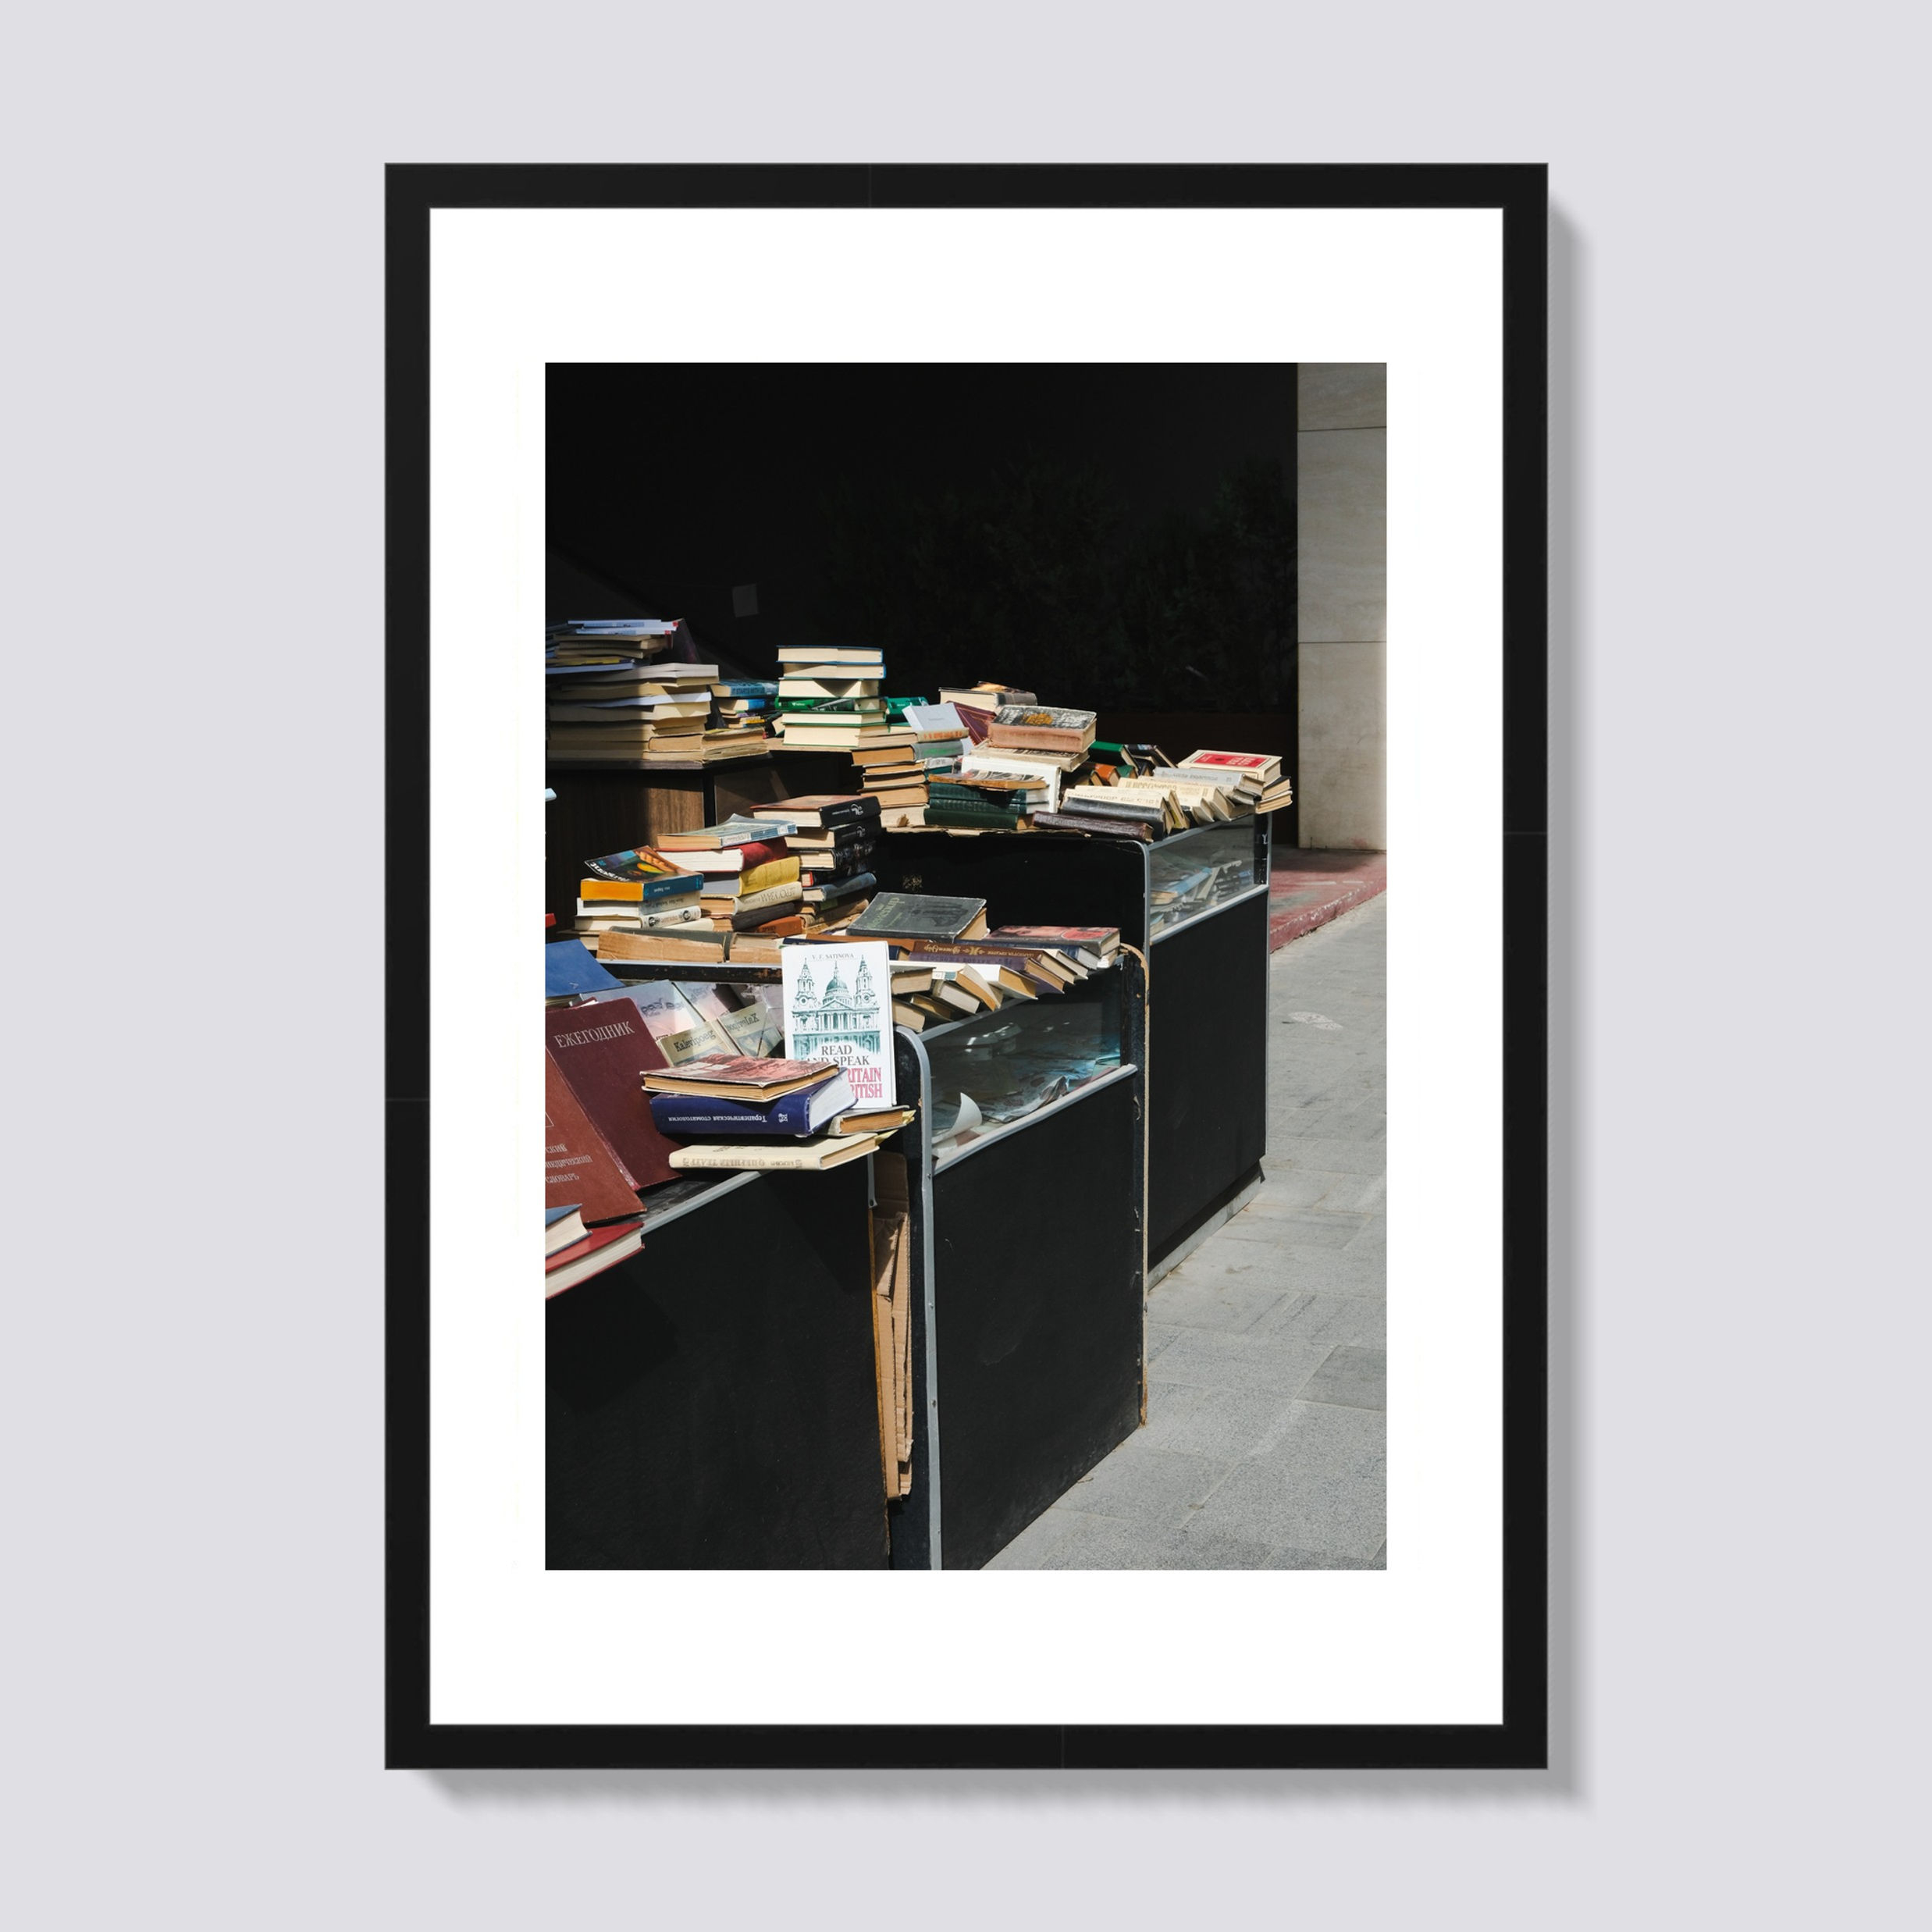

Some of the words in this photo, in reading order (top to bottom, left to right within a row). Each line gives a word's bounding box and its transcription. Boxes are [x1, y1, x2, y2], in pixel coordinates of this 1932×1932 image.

[553, 1020, 635, 1048] ЕЖЕГОДНИК
[674, 1030, 717, 1052] Kalevipoeg
[821, 1044, 852, 1055] READ
[833, 1055, 870, 1066] SPEAK
[713, 1114, 767, 1123] Терапевтическая
[546, 1172, 580, 1184] СЛОВАРЬ
